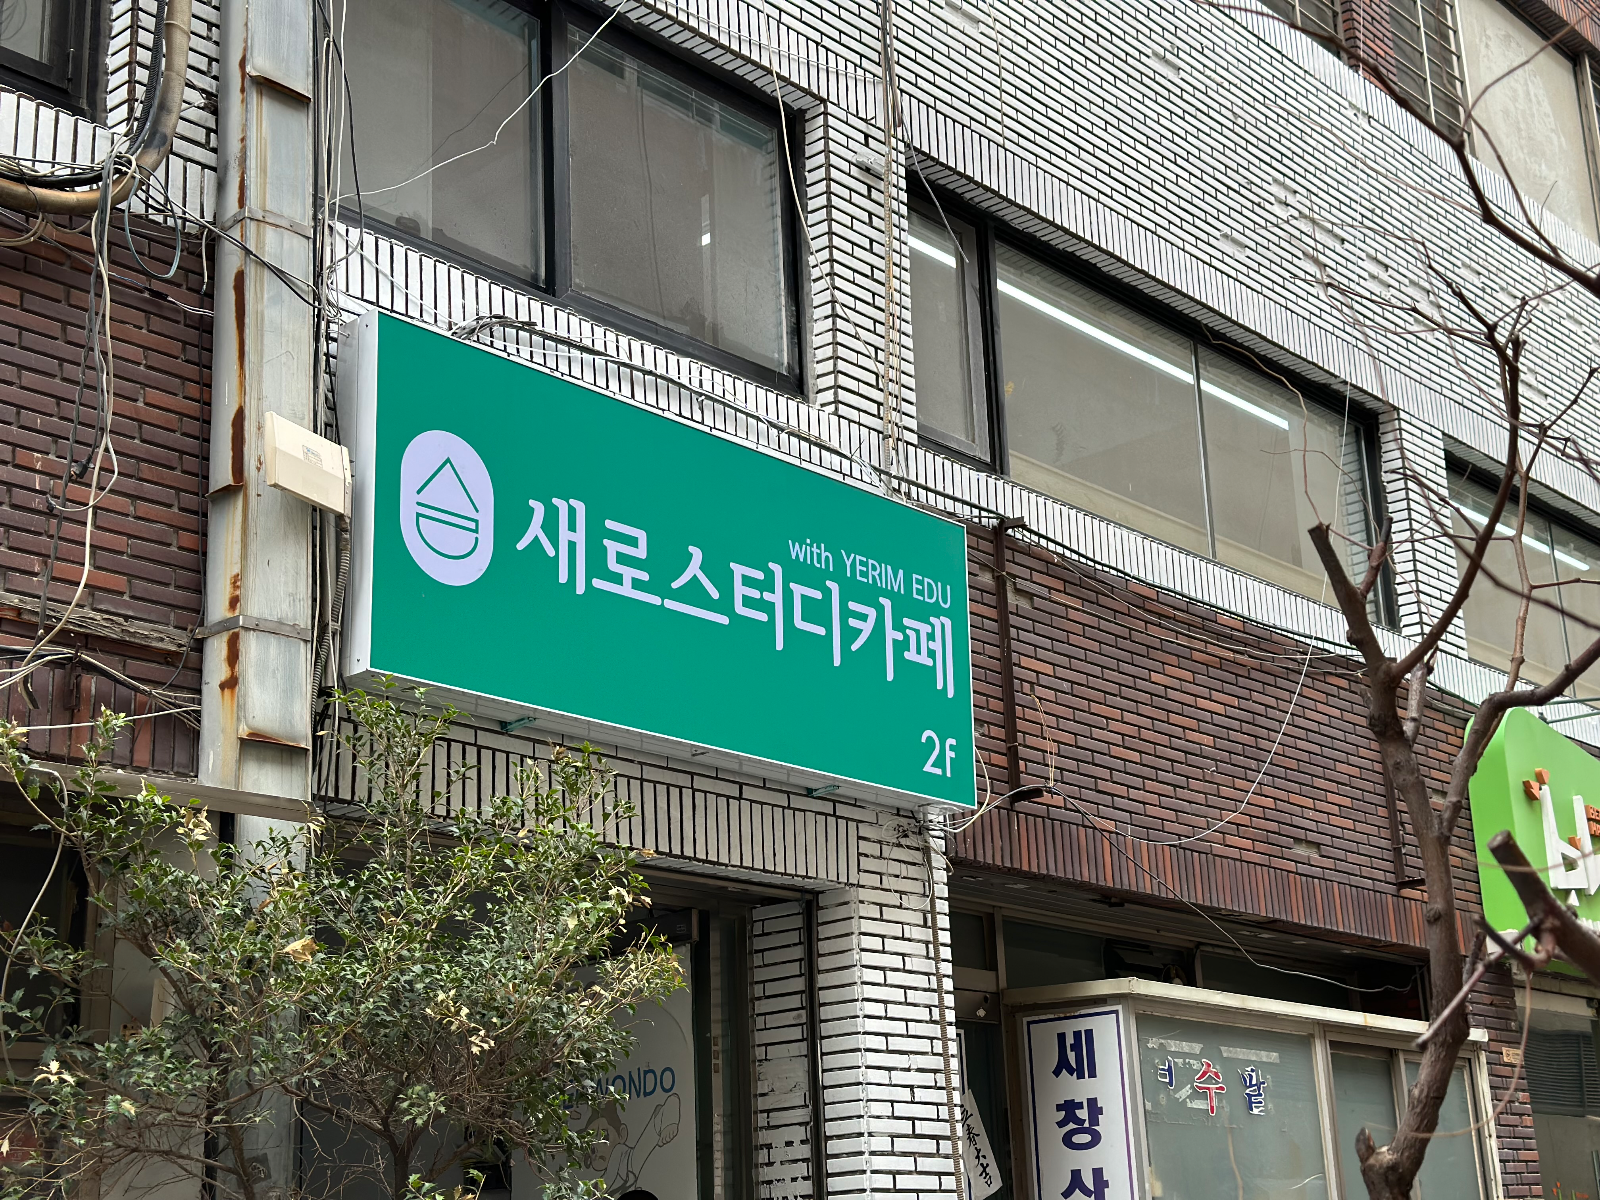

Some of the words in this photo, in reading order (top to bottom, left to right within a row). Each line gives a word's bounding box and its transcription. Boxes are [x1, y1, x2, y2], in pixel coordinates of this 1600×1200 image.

[788, 538, 833, 572] with
[840, 549, 905, 595] YERIM
[912, 573, 951, 609] EDU
